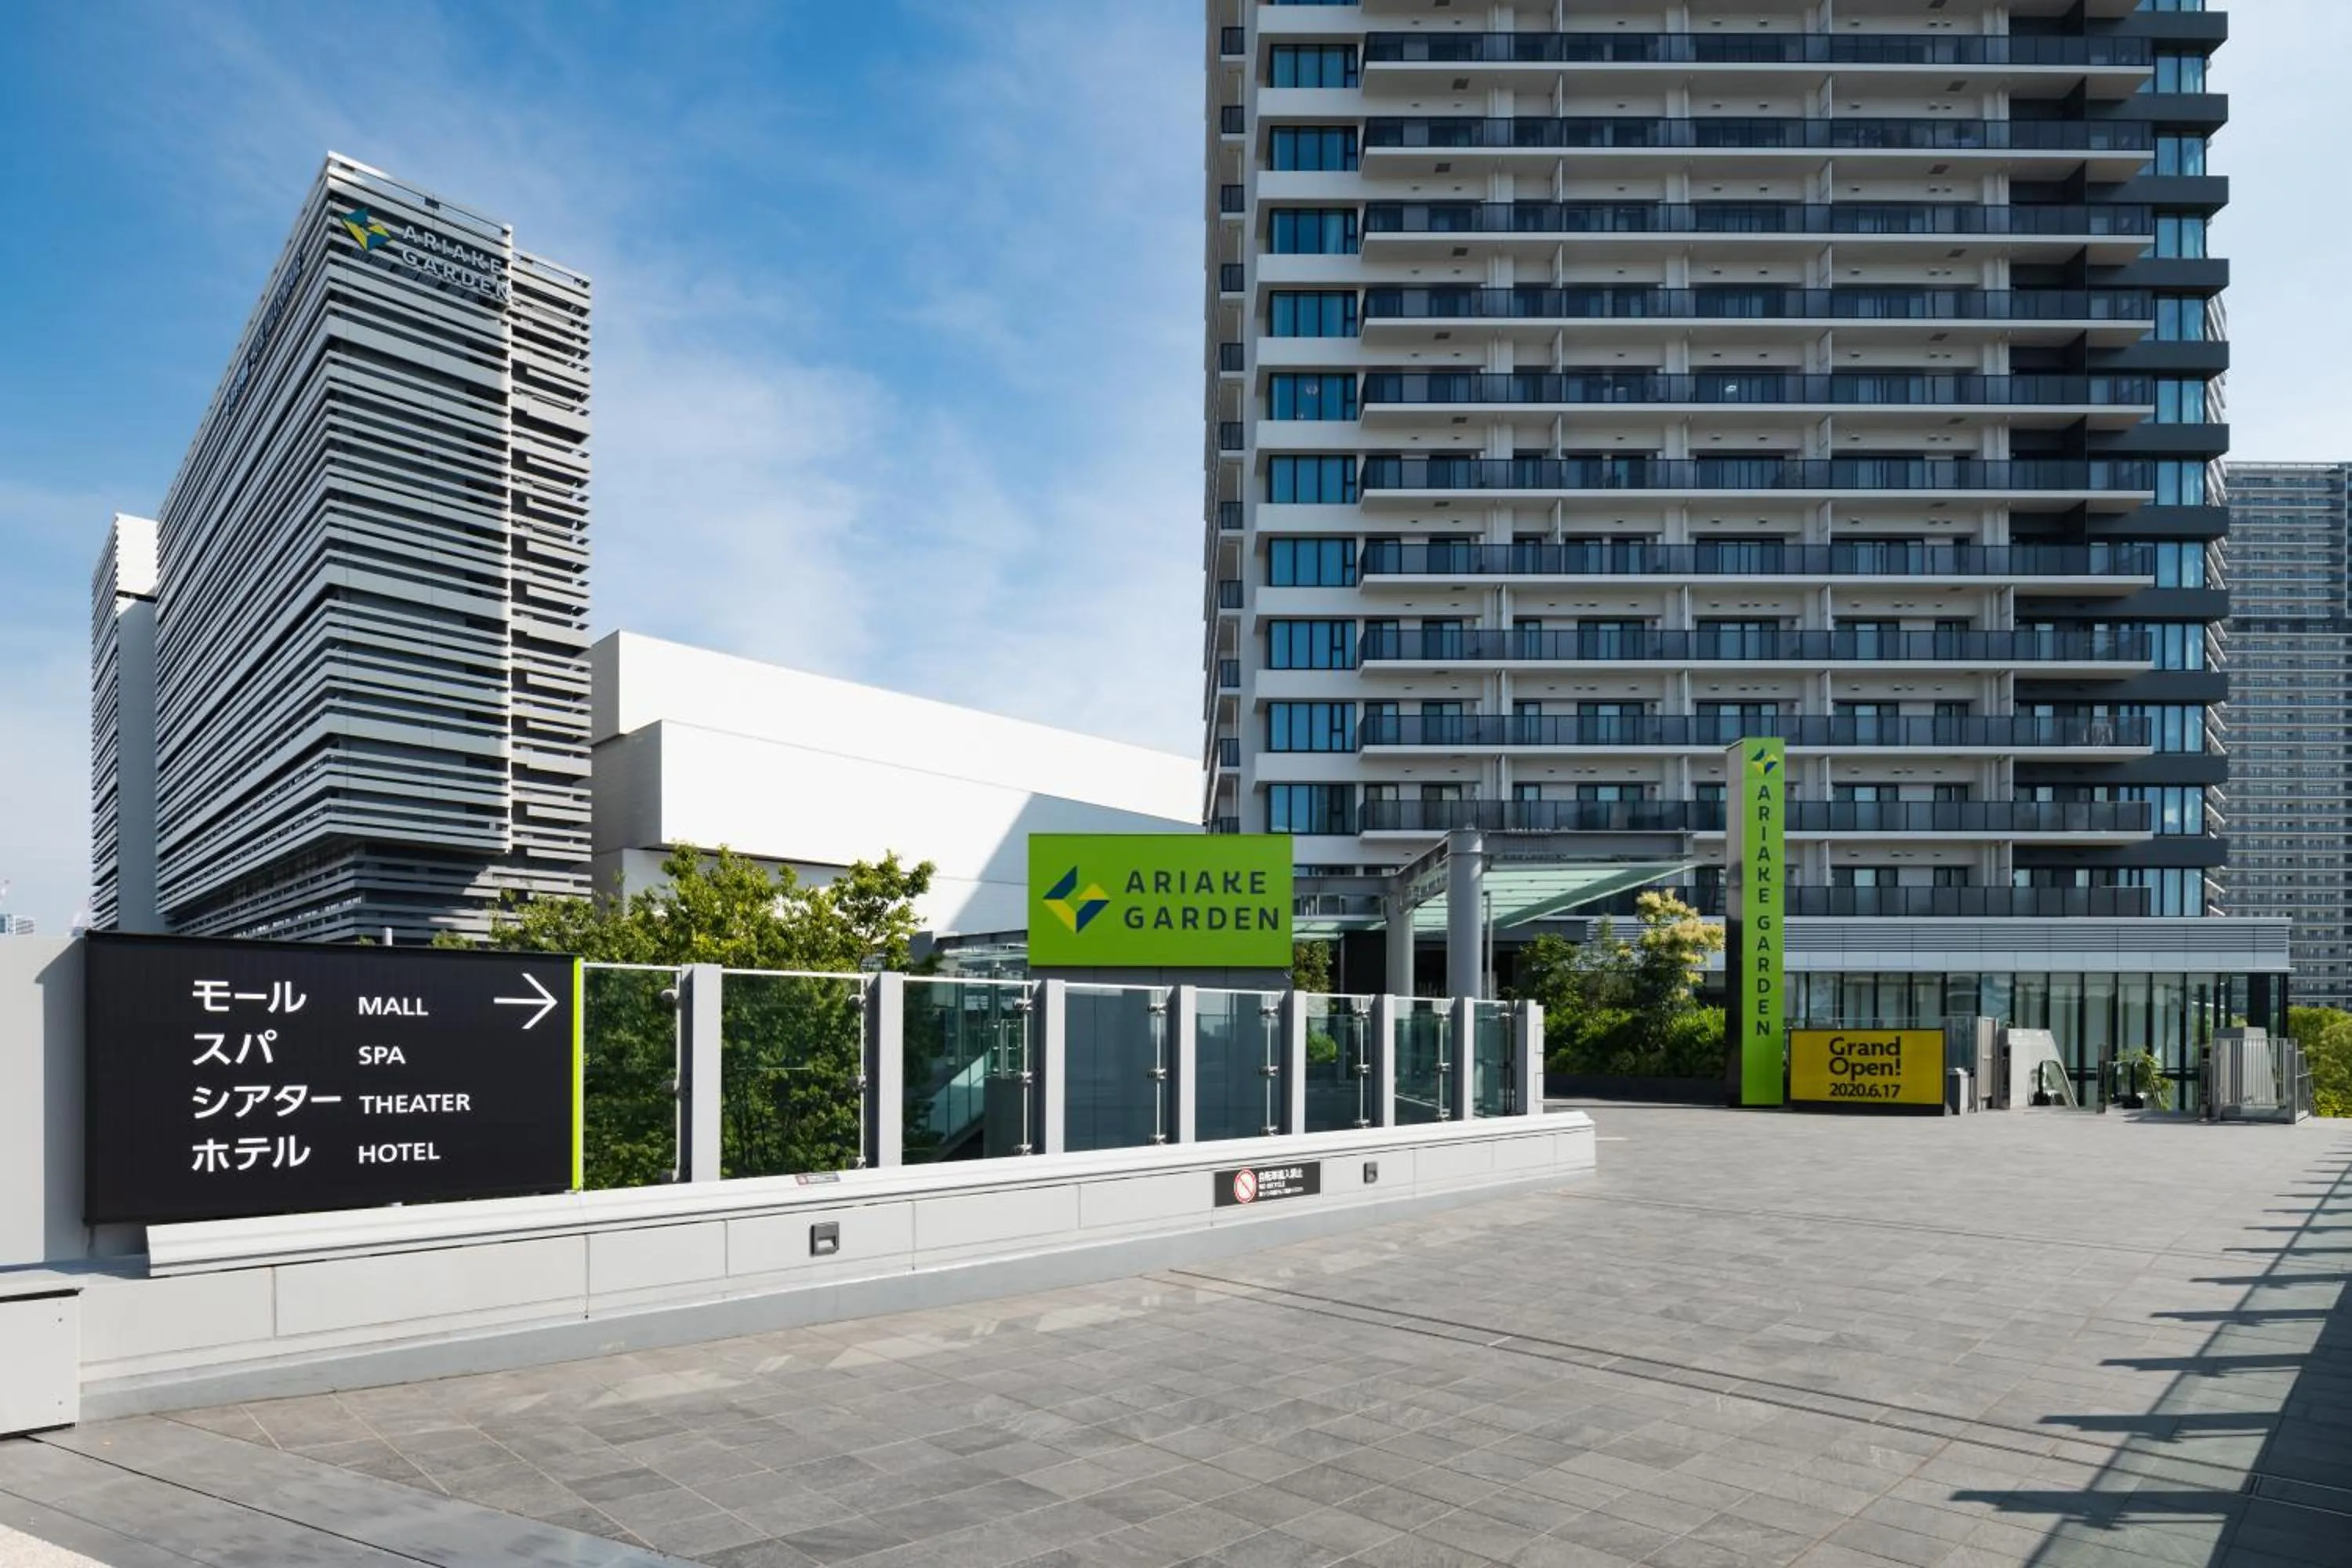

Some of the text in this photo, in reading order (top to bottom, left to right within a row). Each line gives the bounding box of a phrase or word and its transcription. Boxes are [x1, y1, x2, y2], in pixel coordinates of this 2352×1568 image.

[403, 225, 503, 274] ARIAKE
[402, 249, 511, 302] GARDEN
[1124, 870, 1267, 895] ARIAKE
[1123, 906, 1279, 931] GARDEN
[1756, 785, 1771, 1036] ARIAKE GARDEN
[192, 979, 307, 1014] モール
[358, 996, 430, 1017] MALL
[192, 1029, 278, 1066] スパ
[358, 1045, 407, 1065] SPA
[1828, 1036, 1901, 1056] Grand
[1828, 1057, 1901, 1081] Open!
[192, 1084, 342, 1119] シアター
[1829, 1083, 1901, 1098] 2020.6.17
[359, 1094, 471, 1114] THEATER
[191, 1135, 311, 1172] ホテル
[358, 1142, 441, 1164] HOTEL
